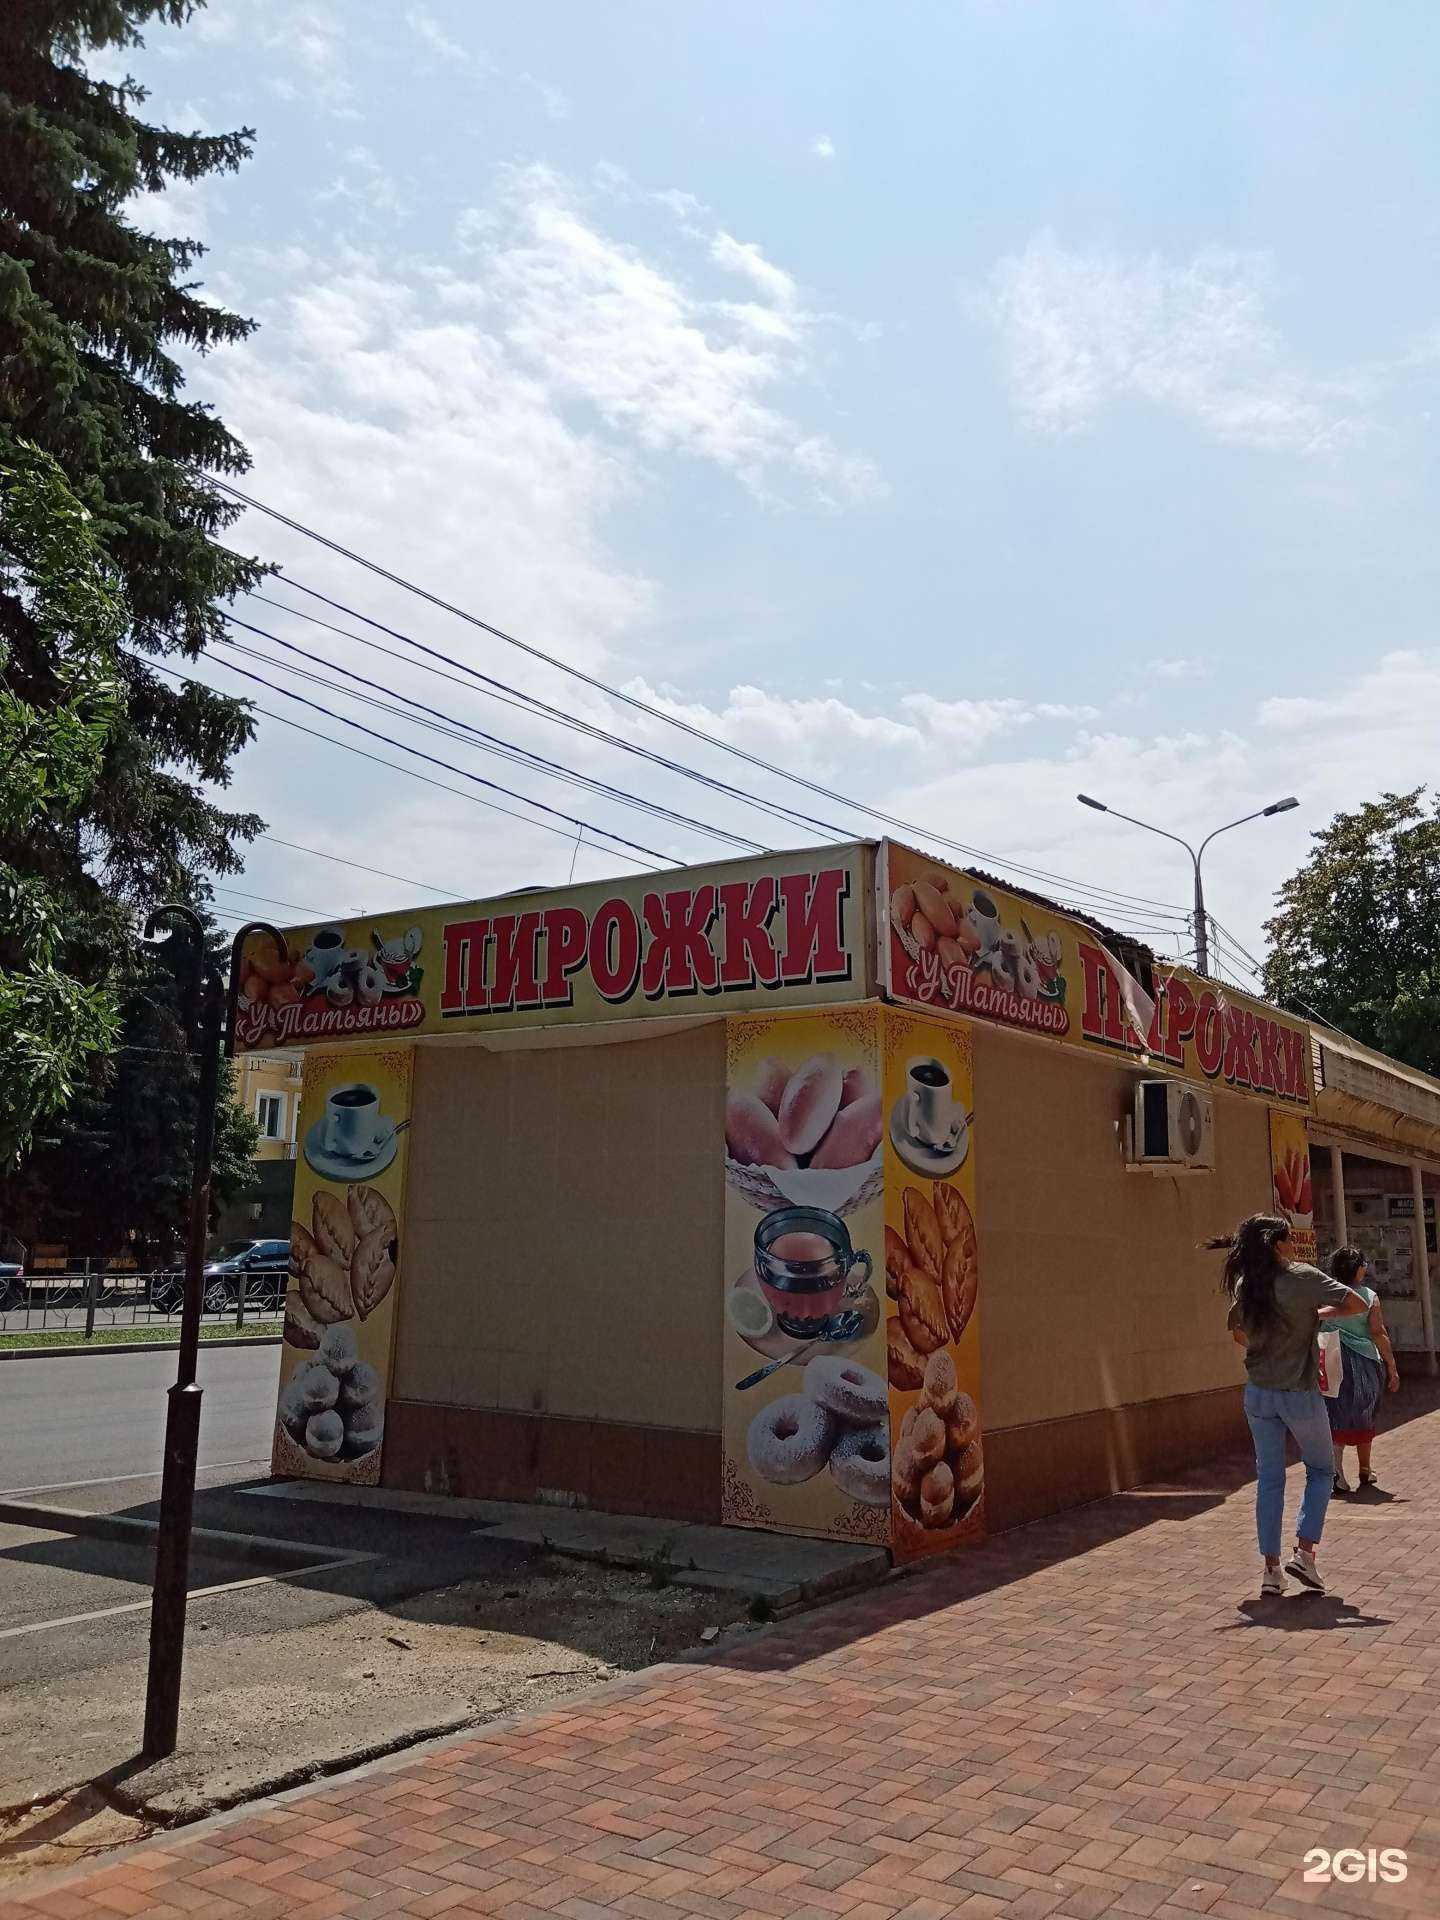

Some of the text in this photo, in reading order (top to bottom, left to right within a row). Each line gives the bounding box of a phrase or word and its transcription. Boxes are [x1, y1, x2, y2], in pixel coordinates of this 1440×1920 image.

[441, 868, 851, 1018] ПИРОЖКИ
[273, 1002, 422, 1041] Татьяны»
[949, 965, 1068, 1030] Татьяны»
